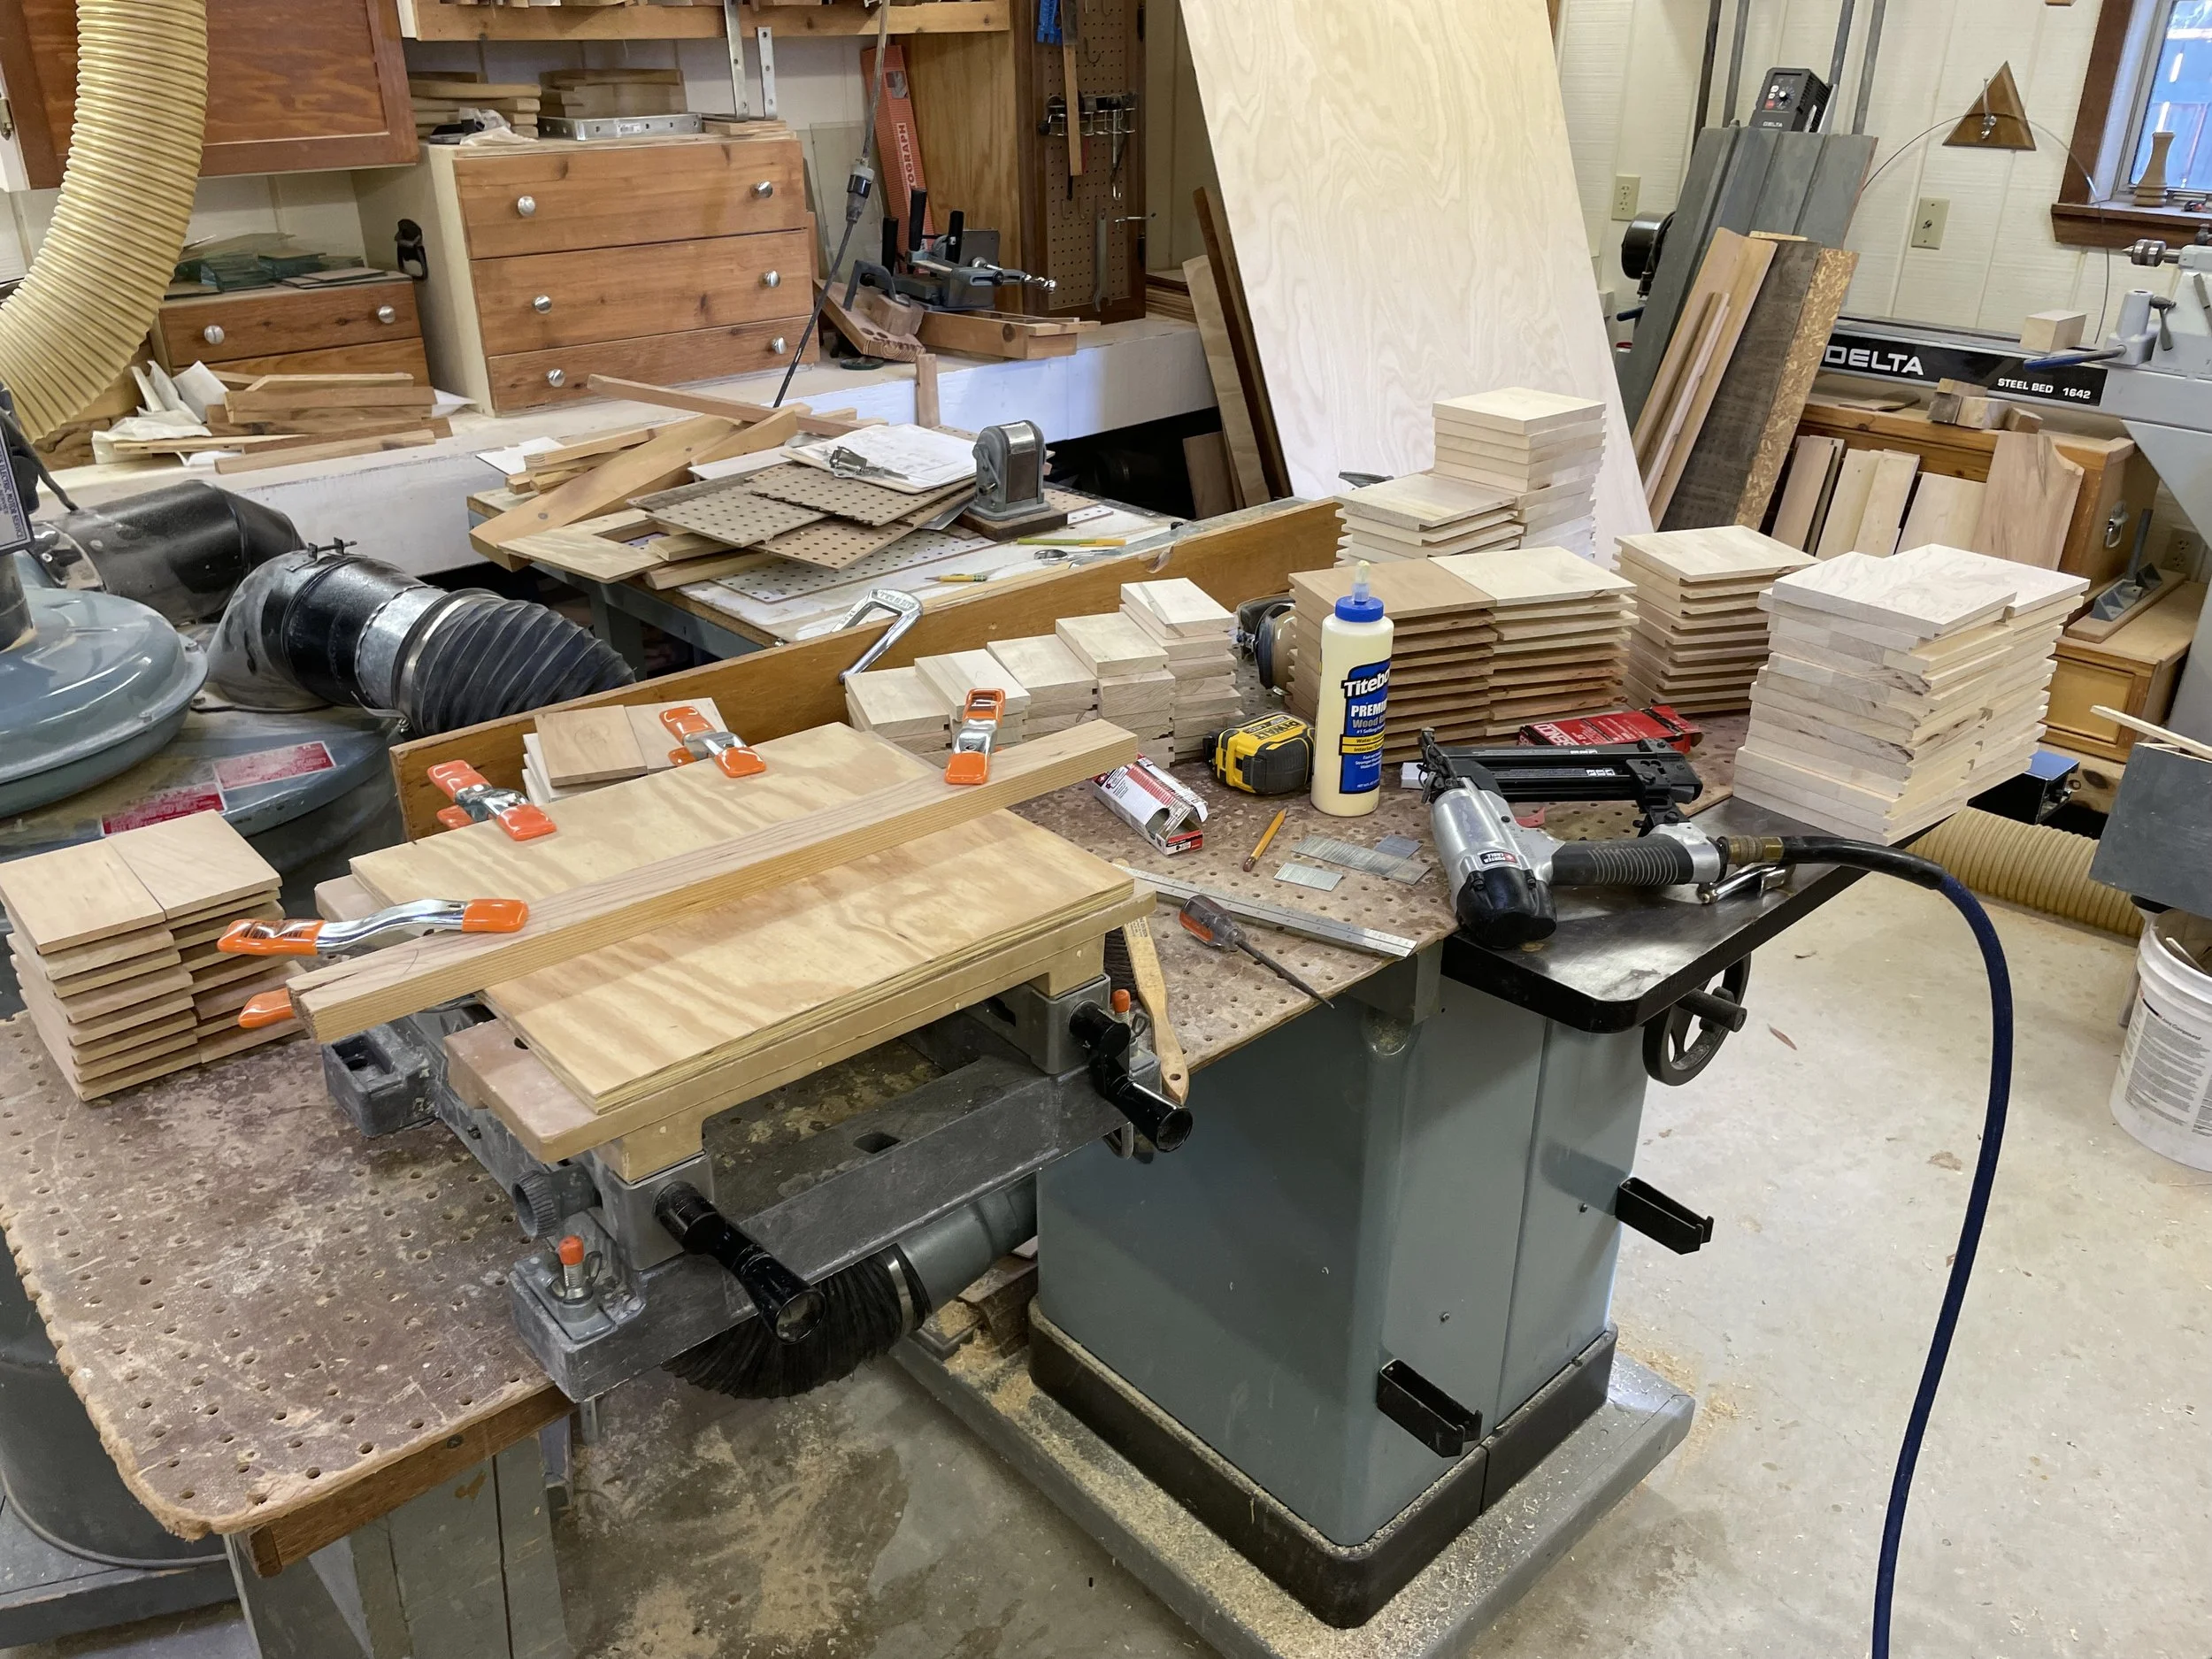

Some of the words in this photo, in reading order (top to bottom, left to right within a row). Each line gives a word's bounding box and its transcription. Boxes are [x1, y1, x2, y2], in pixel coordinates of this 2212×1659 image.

[1824, 346, 1924, 376] DELTA
[1998, 378, 2029, 390] STEEL
[2032, 382, 2054, 394] BED
[2062, 387, 2092, 399] 1642
[1353, 717, 1379, 728] Wood
